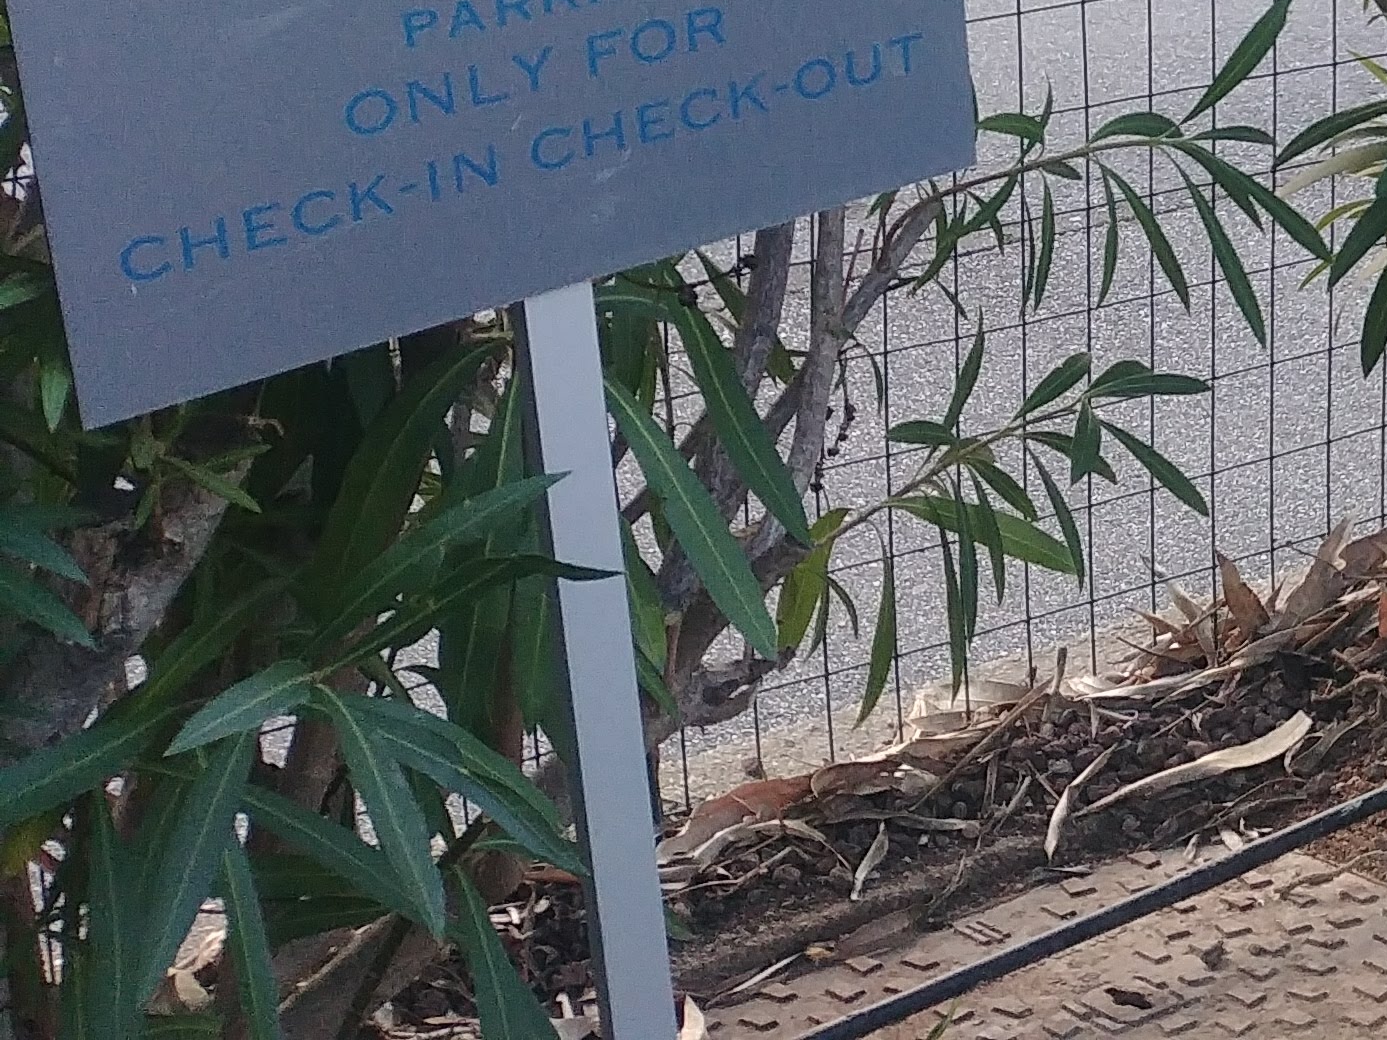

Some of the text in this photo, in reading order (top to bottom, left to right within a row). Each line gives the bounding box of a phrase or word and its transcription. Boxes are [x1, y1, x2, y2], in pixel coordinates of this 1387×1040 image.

[118, 32, 924, 283] CHECK-IN CHECK-OUT
[344, 6, 728, 136] ONLY FOR
